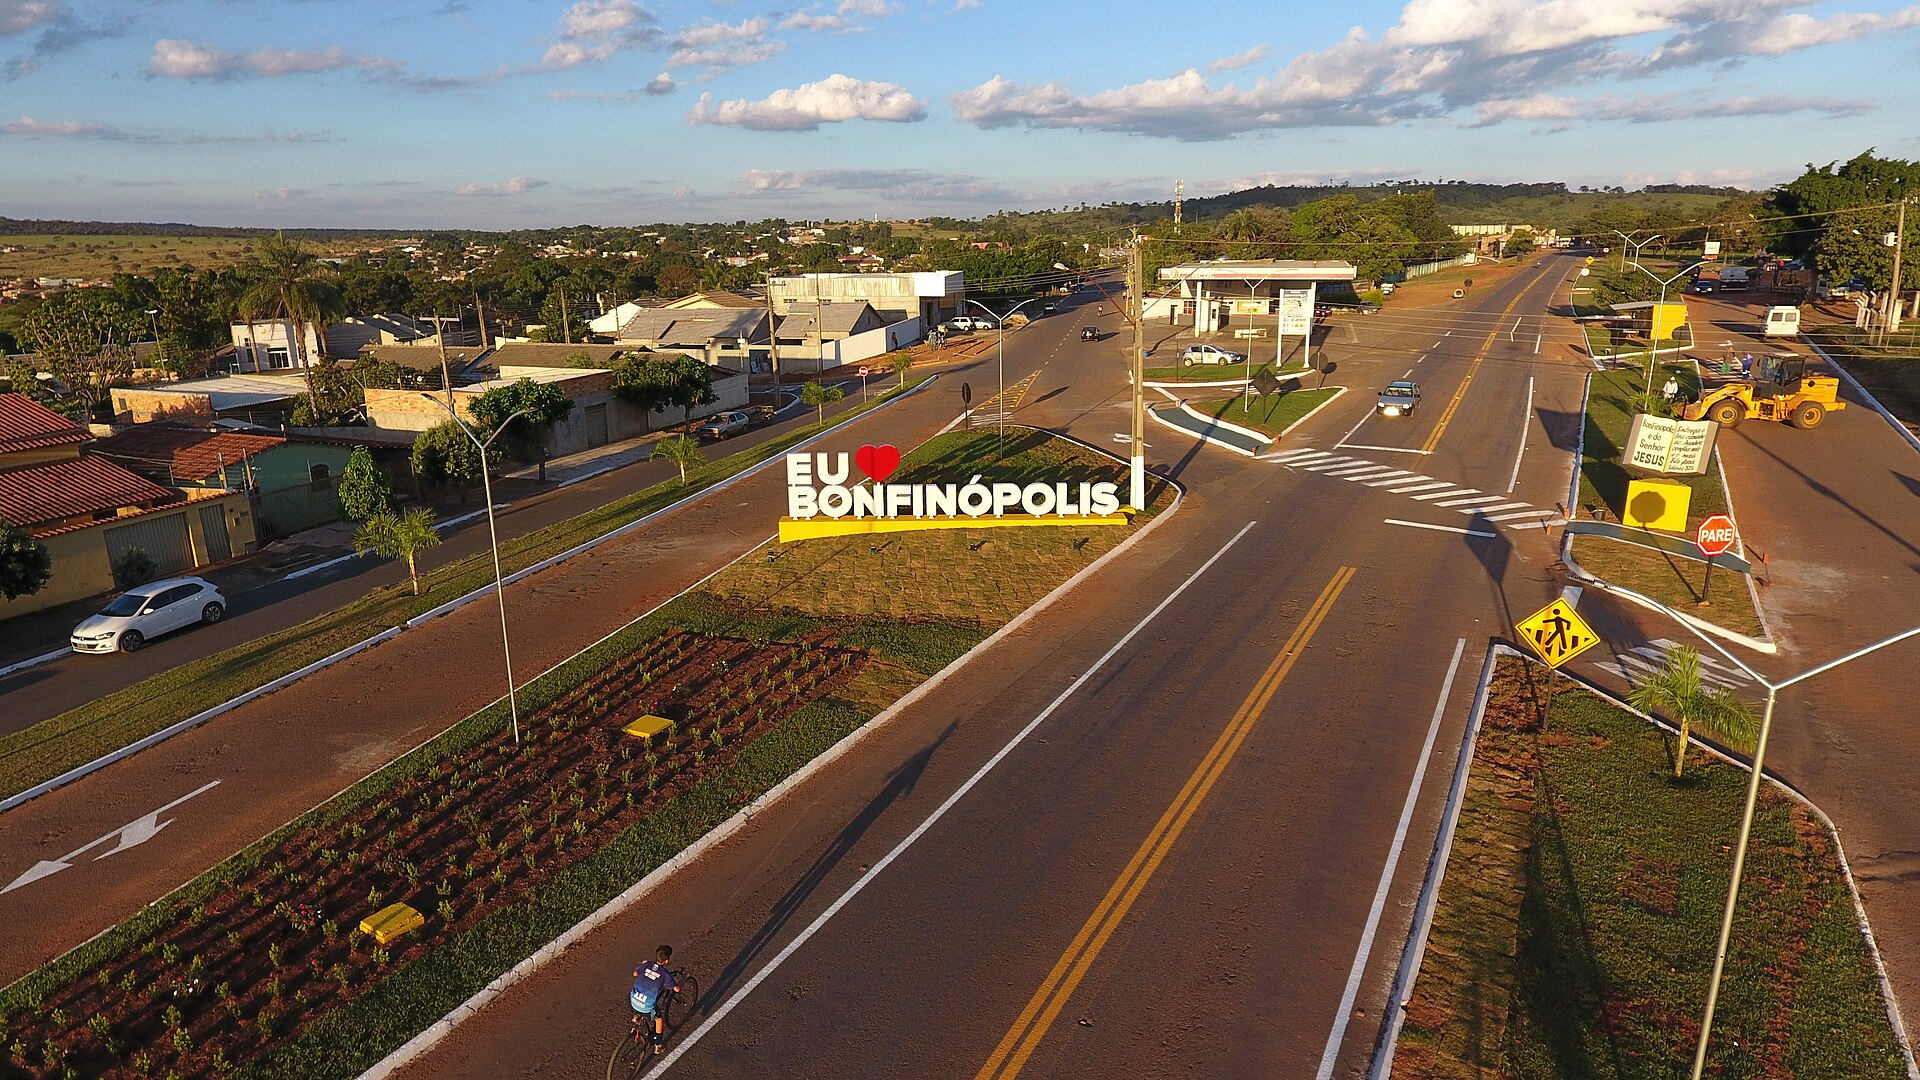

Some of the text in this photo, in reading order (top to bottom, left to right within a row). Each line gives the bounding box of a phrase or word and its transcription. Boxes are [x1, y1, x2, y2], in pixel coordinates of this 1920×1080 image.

[1640, 439, 1666, 452] Senhor
[1634, 451, 1665, 466] JESUS
[787, 452, 850, 485] EU
[788, 474, 1120, 517] BONFINÓPOLIS
[1701, 528, 1732, 542] PARE
